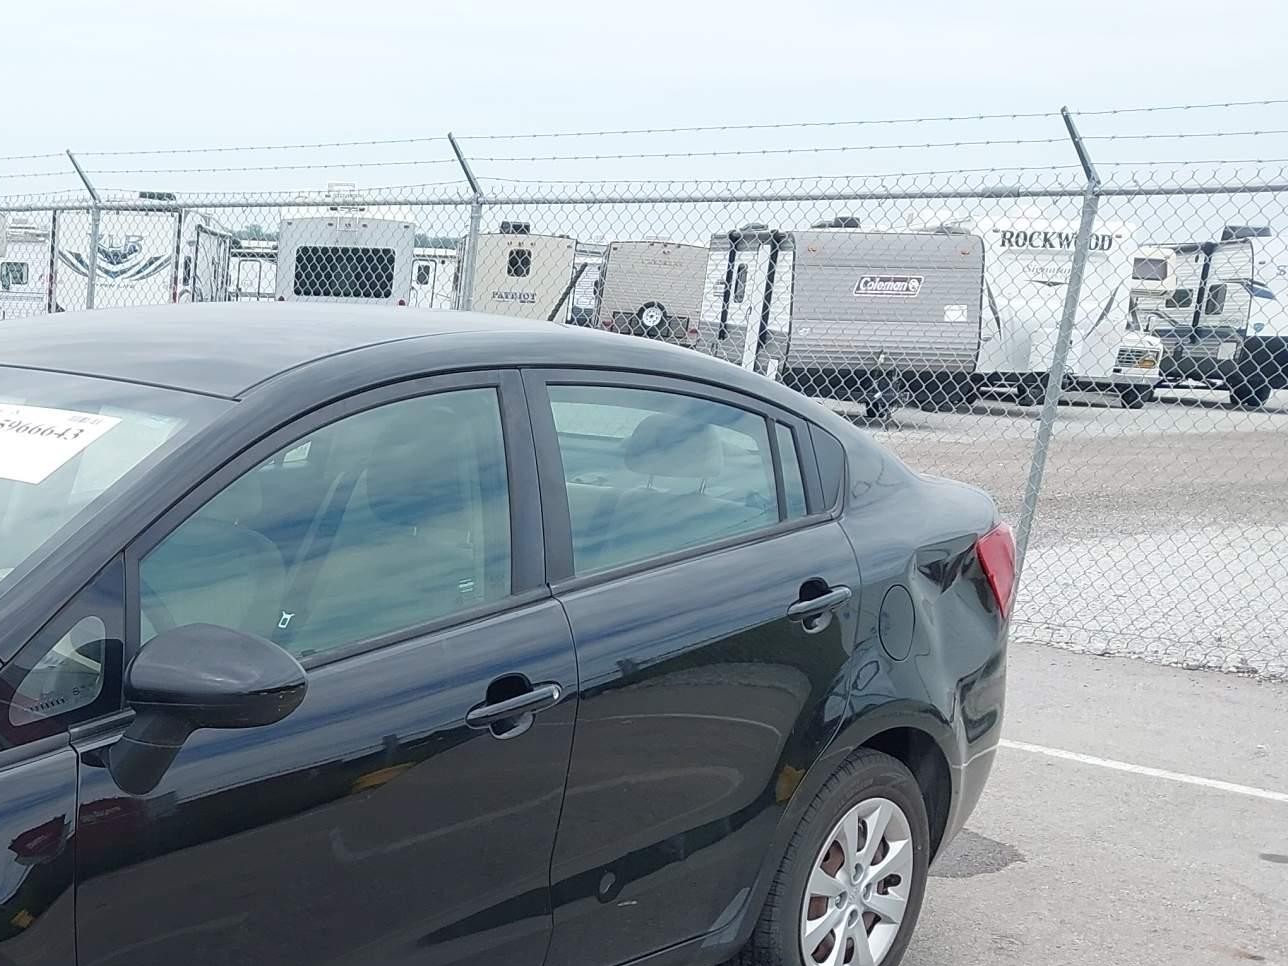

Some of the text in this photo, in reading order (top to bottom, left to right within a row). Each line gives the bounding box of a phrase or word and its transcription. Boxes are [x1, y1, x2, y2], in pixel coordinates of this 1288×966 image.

[1000, 230, 1113, 251] ROCKWOD
[861, 277, 908, 292] Coleman
[492, 291, 537, 300] PATRIOT
